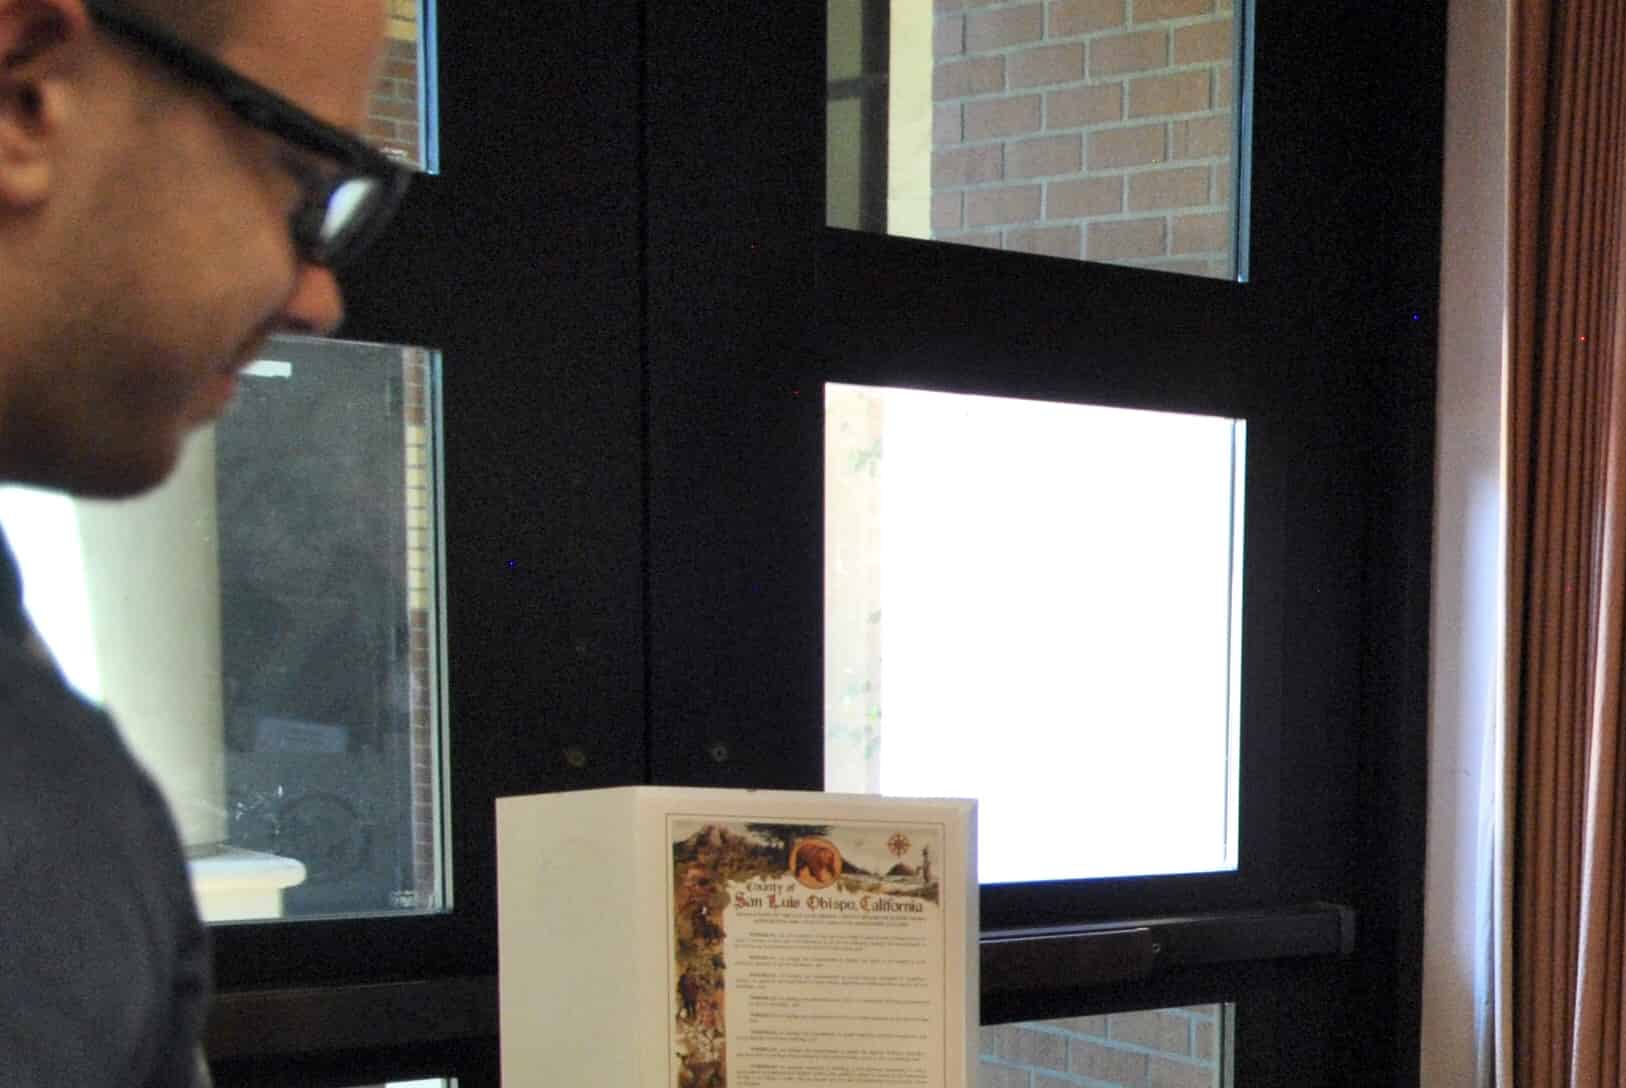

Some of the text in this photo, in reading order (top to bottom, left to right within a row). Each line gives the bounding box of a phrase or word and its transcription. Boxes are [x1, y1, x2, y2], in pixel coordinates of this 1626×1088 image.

[735, 894, 762, 909] San
[768, 894, 800, 910] Luis
[859, 895, 923, 913] California
